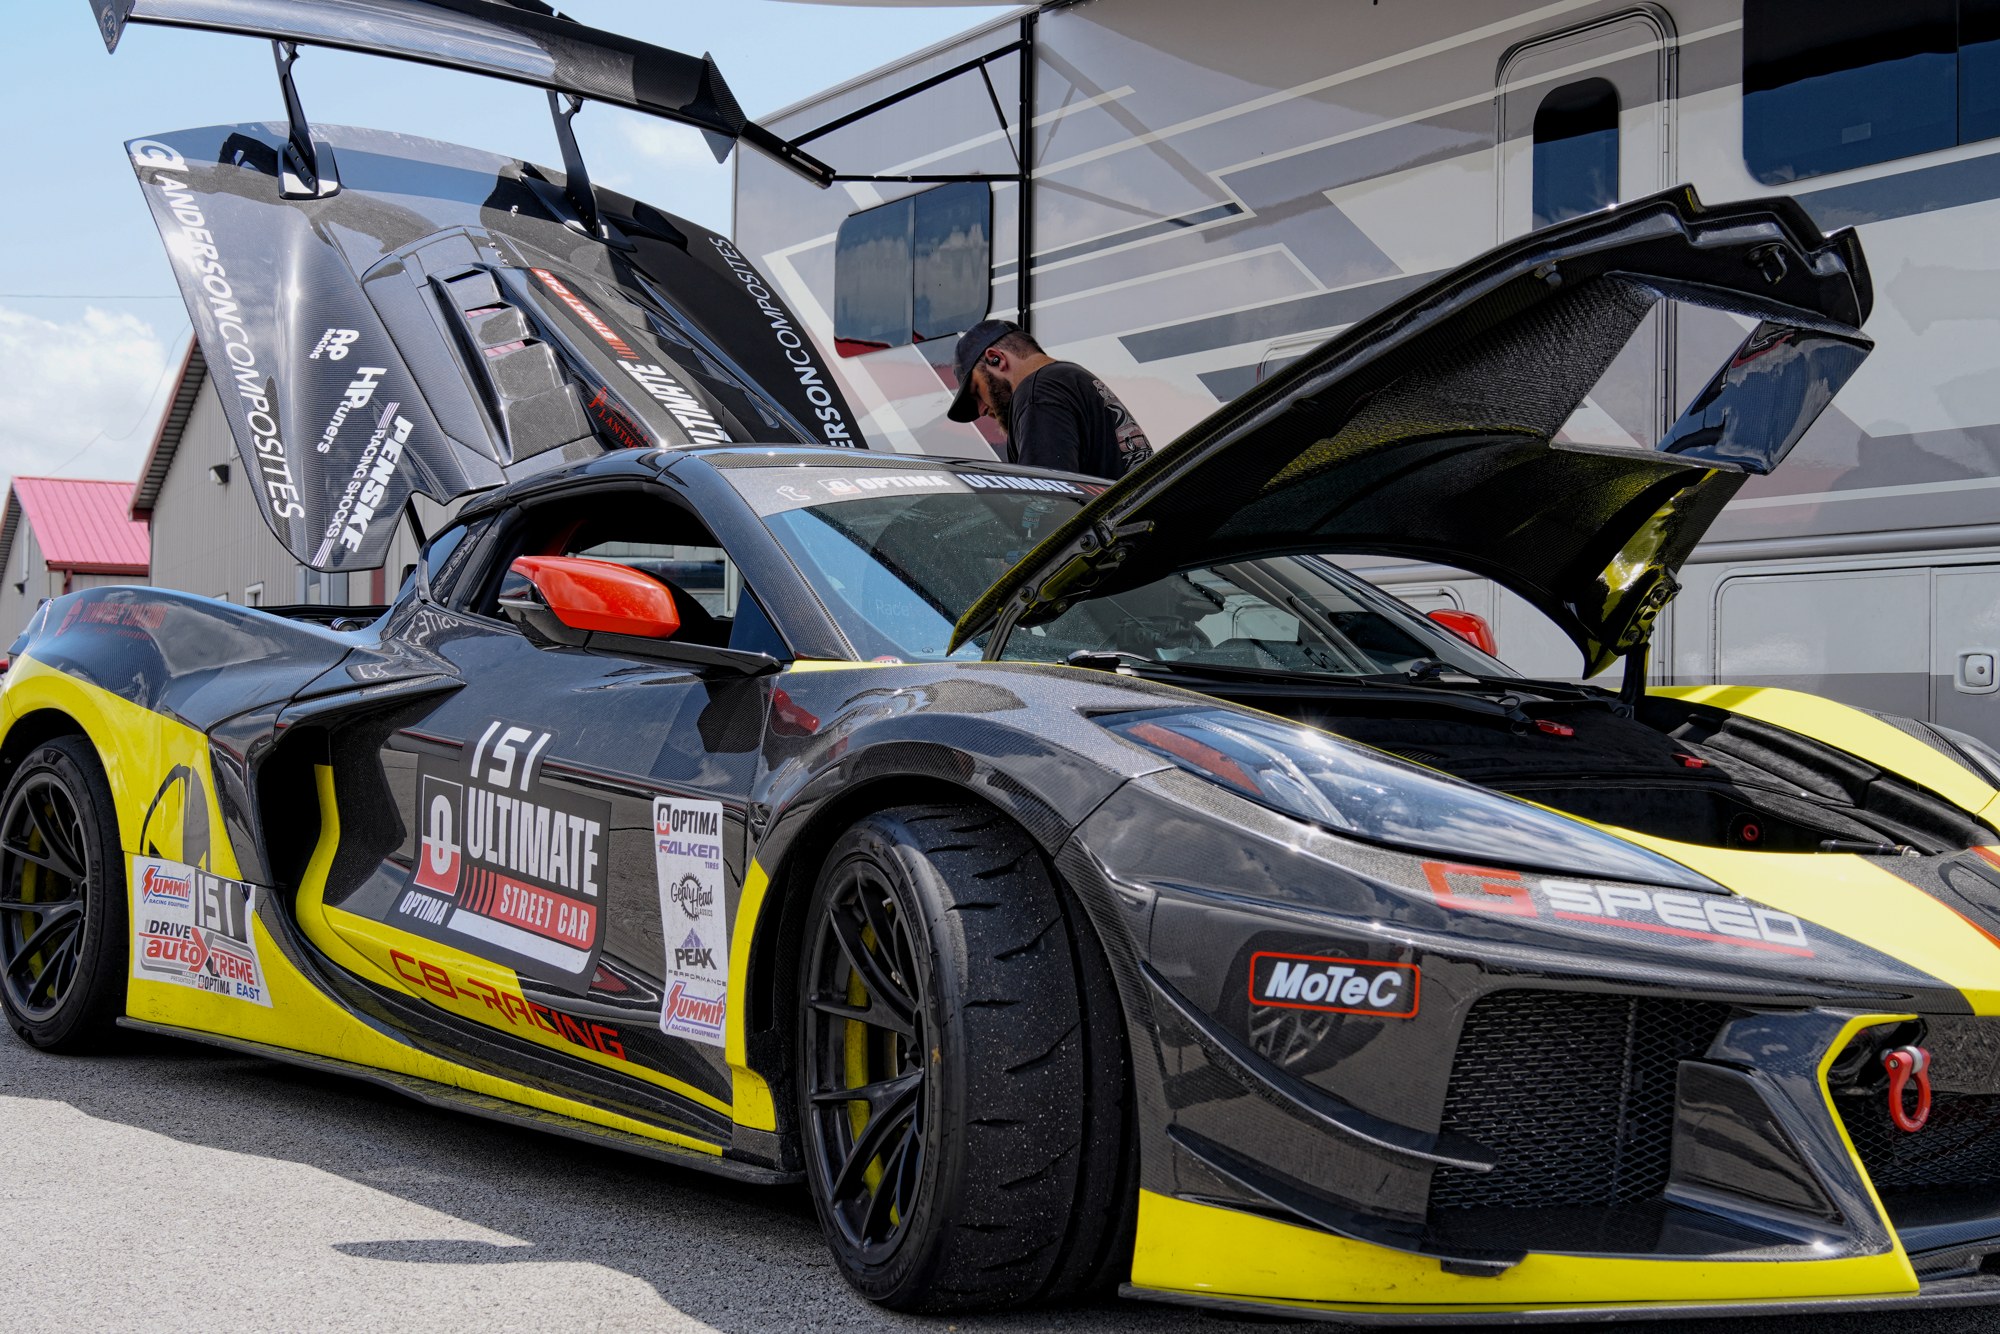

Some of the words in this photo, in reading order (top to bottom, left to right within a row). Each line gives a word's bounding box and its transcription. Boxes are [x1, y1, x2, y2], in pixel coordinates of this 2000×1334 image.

[155, 174, 304, 518] ANDERSONCOMPOSITES
[344, 367, 387, 408] HP
[317, 400, 351, 453] tuners
[353, 429, 386, 479] RACING
[340, 415, 414, 553] PENSKE
[855, 475, 951, 490] OPTIMA
[956, 473, 1085, 495] ULTIMATE
[326, 480, 360, 538] SHOCKS
[470, 721, 551, 792] 151
[467, 786, 600, 896] ULTIMATE
[671, 809, 718, 836] OPTIMA
[659, 839, 719, 860] FALKEN
[704, 861, 719, 870] TIRES
[197, 873, 235, 937] 151
[399, 890, 449, 925] OPTIMA
[500, 883, 554, 929] STREET
[557, 903, 589, 942] CAR
[149, 920, 191, 939] DRIVE
[675, 947, 717, 970] PEAK
[204, 976, 231, 995] OPTIMA
[236, 983, 260, 1001] EAST
[667, 969, 727, 987] PERFORMANCE
[1265, 961, 1402, 1008] MoTeC
[671, 1023, 690, 1034] RACING
[691, 1027, 721, 1040] EQUIPMENT
